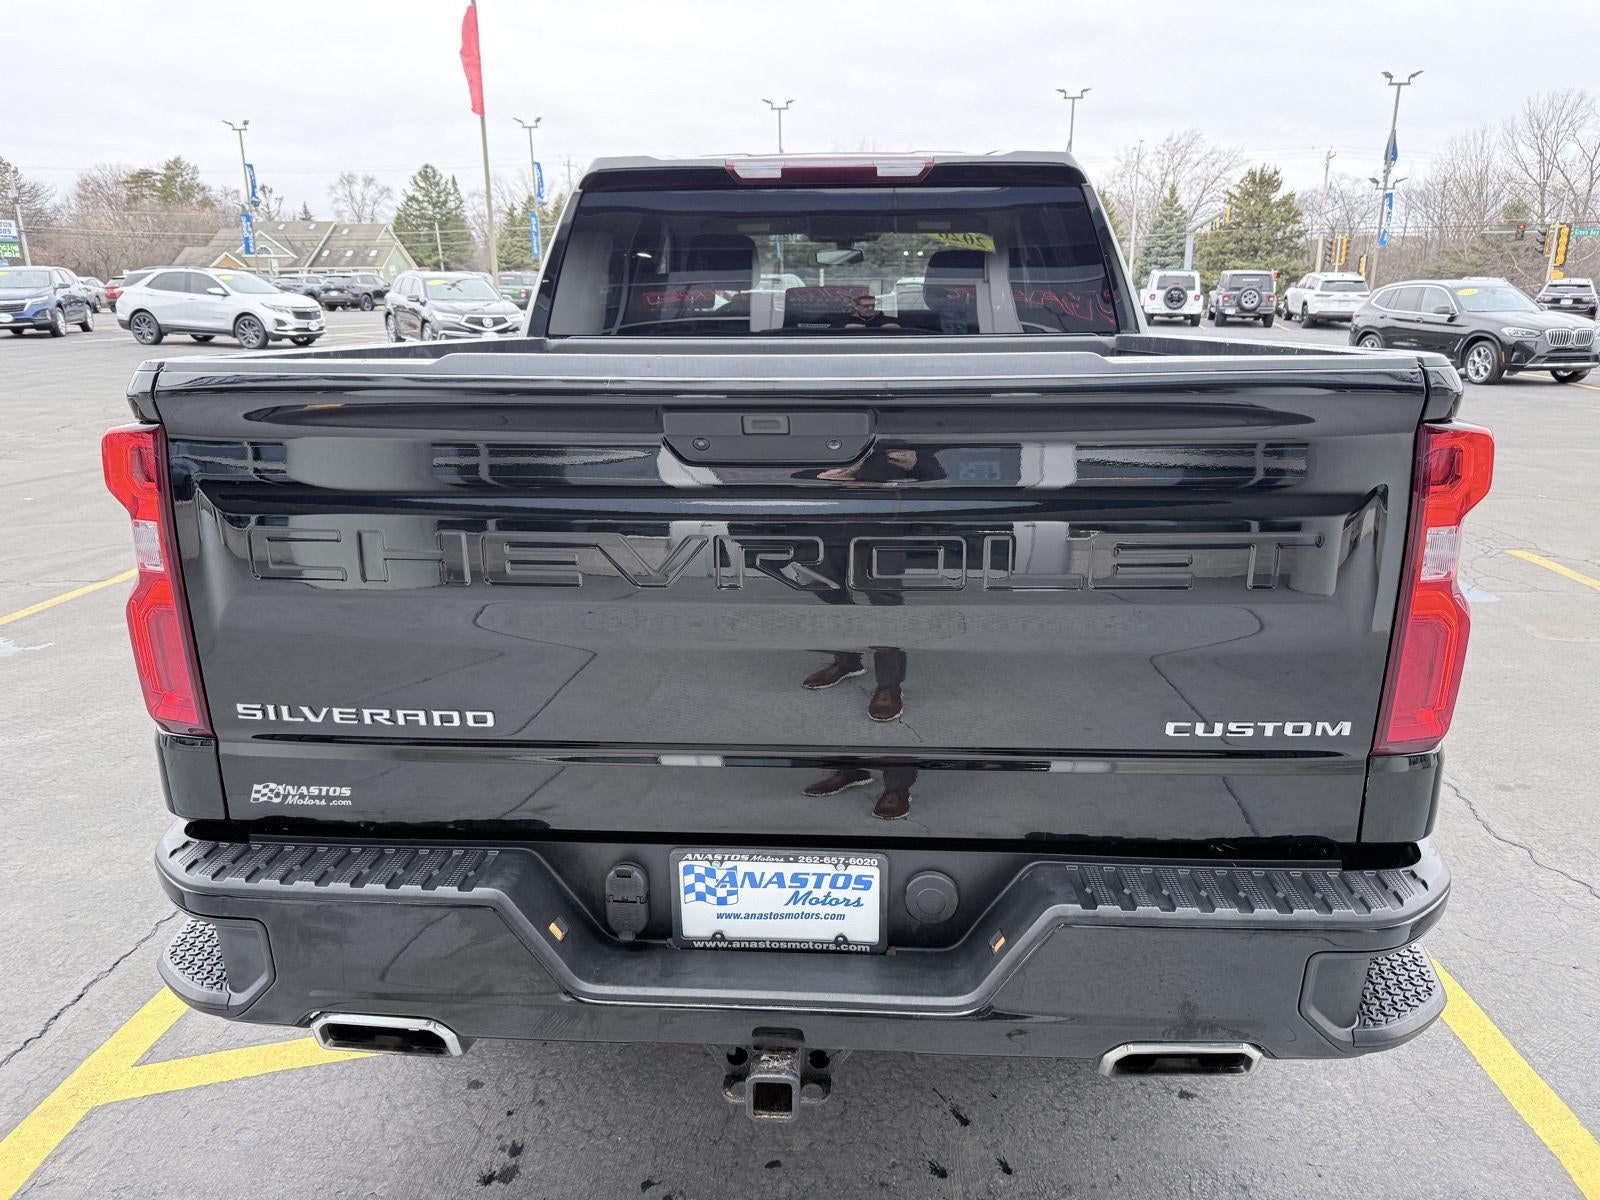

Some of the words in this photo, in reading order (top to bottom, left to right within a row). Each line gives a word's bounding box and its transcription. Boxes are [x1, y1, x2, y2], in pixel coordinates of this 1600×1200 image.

[248, 528, 1326, 591] CHEVROLET
[235, 703, 496, 728] SILVERADO
[1165, 721, 1352, 737] CUSTOM
[273, 784, 352, 797] ANASTOS
[284, 795, 327, 806] Motors
[682, 853, 749, 861] ANASTOS
[749, 855, 785, 863] Motors
[797, 855, 878, 866] 262-657-6020
[716, 871, 874, 891] ANASTOS
[784, 890, 864, 908] Motors
[716, 910, 846, 921] www.anastosmotors.com
[693, 940, 871, 952] www.anastosmotors.com
